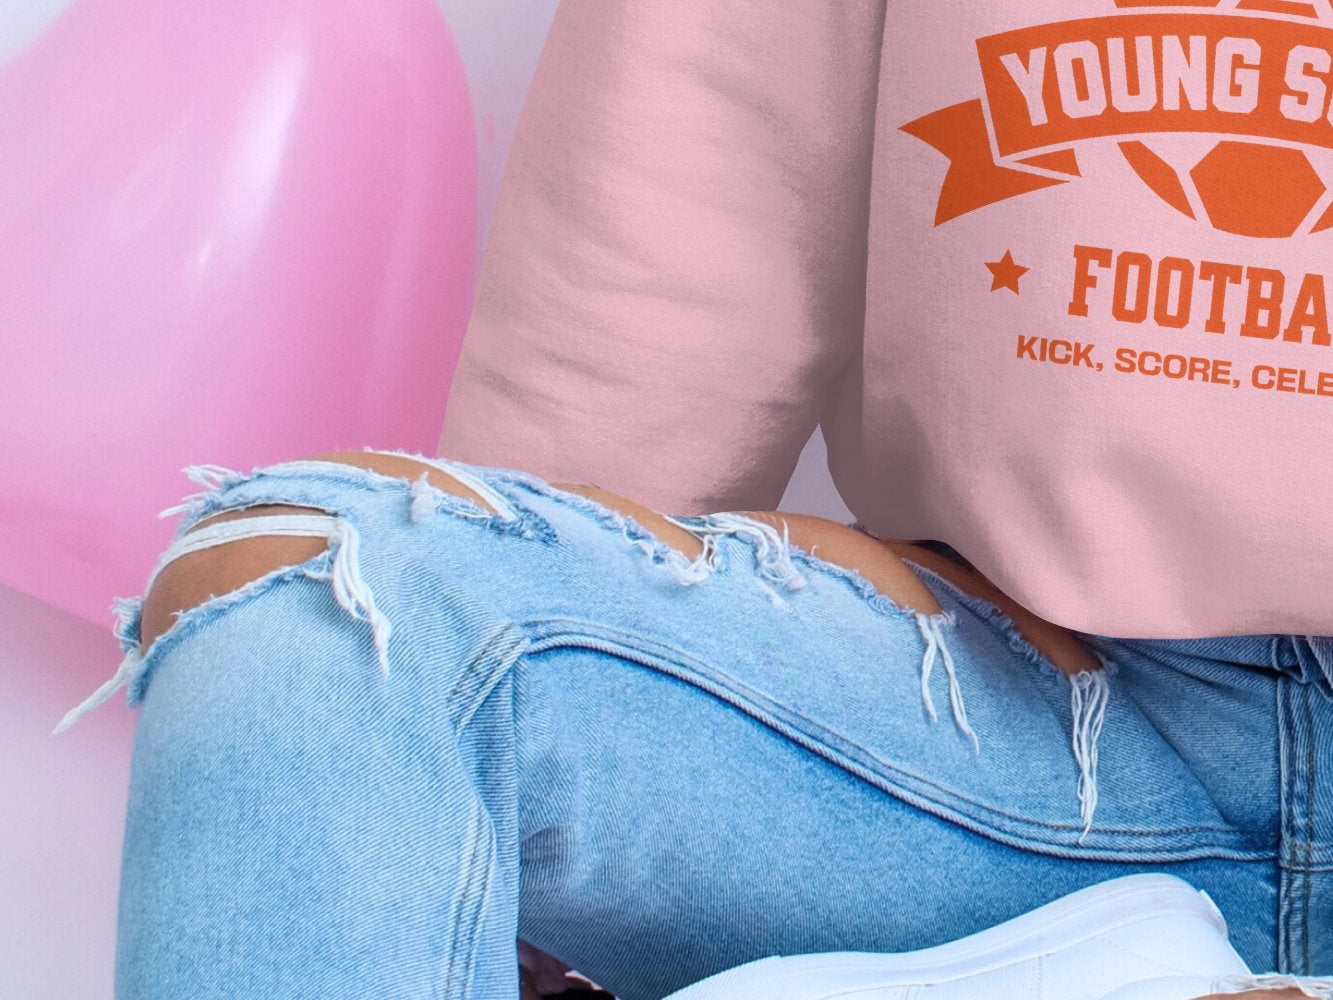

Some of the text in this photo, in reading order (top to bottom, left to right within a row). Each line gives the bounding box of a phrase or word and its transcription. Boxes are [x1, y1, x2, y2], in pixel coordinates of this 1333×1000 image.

[1000, 35, 1263, 127] YOUNG
[1016, 335, 1104, 372] KICK,
[1115, 347, 1241, 389] SCORE,
